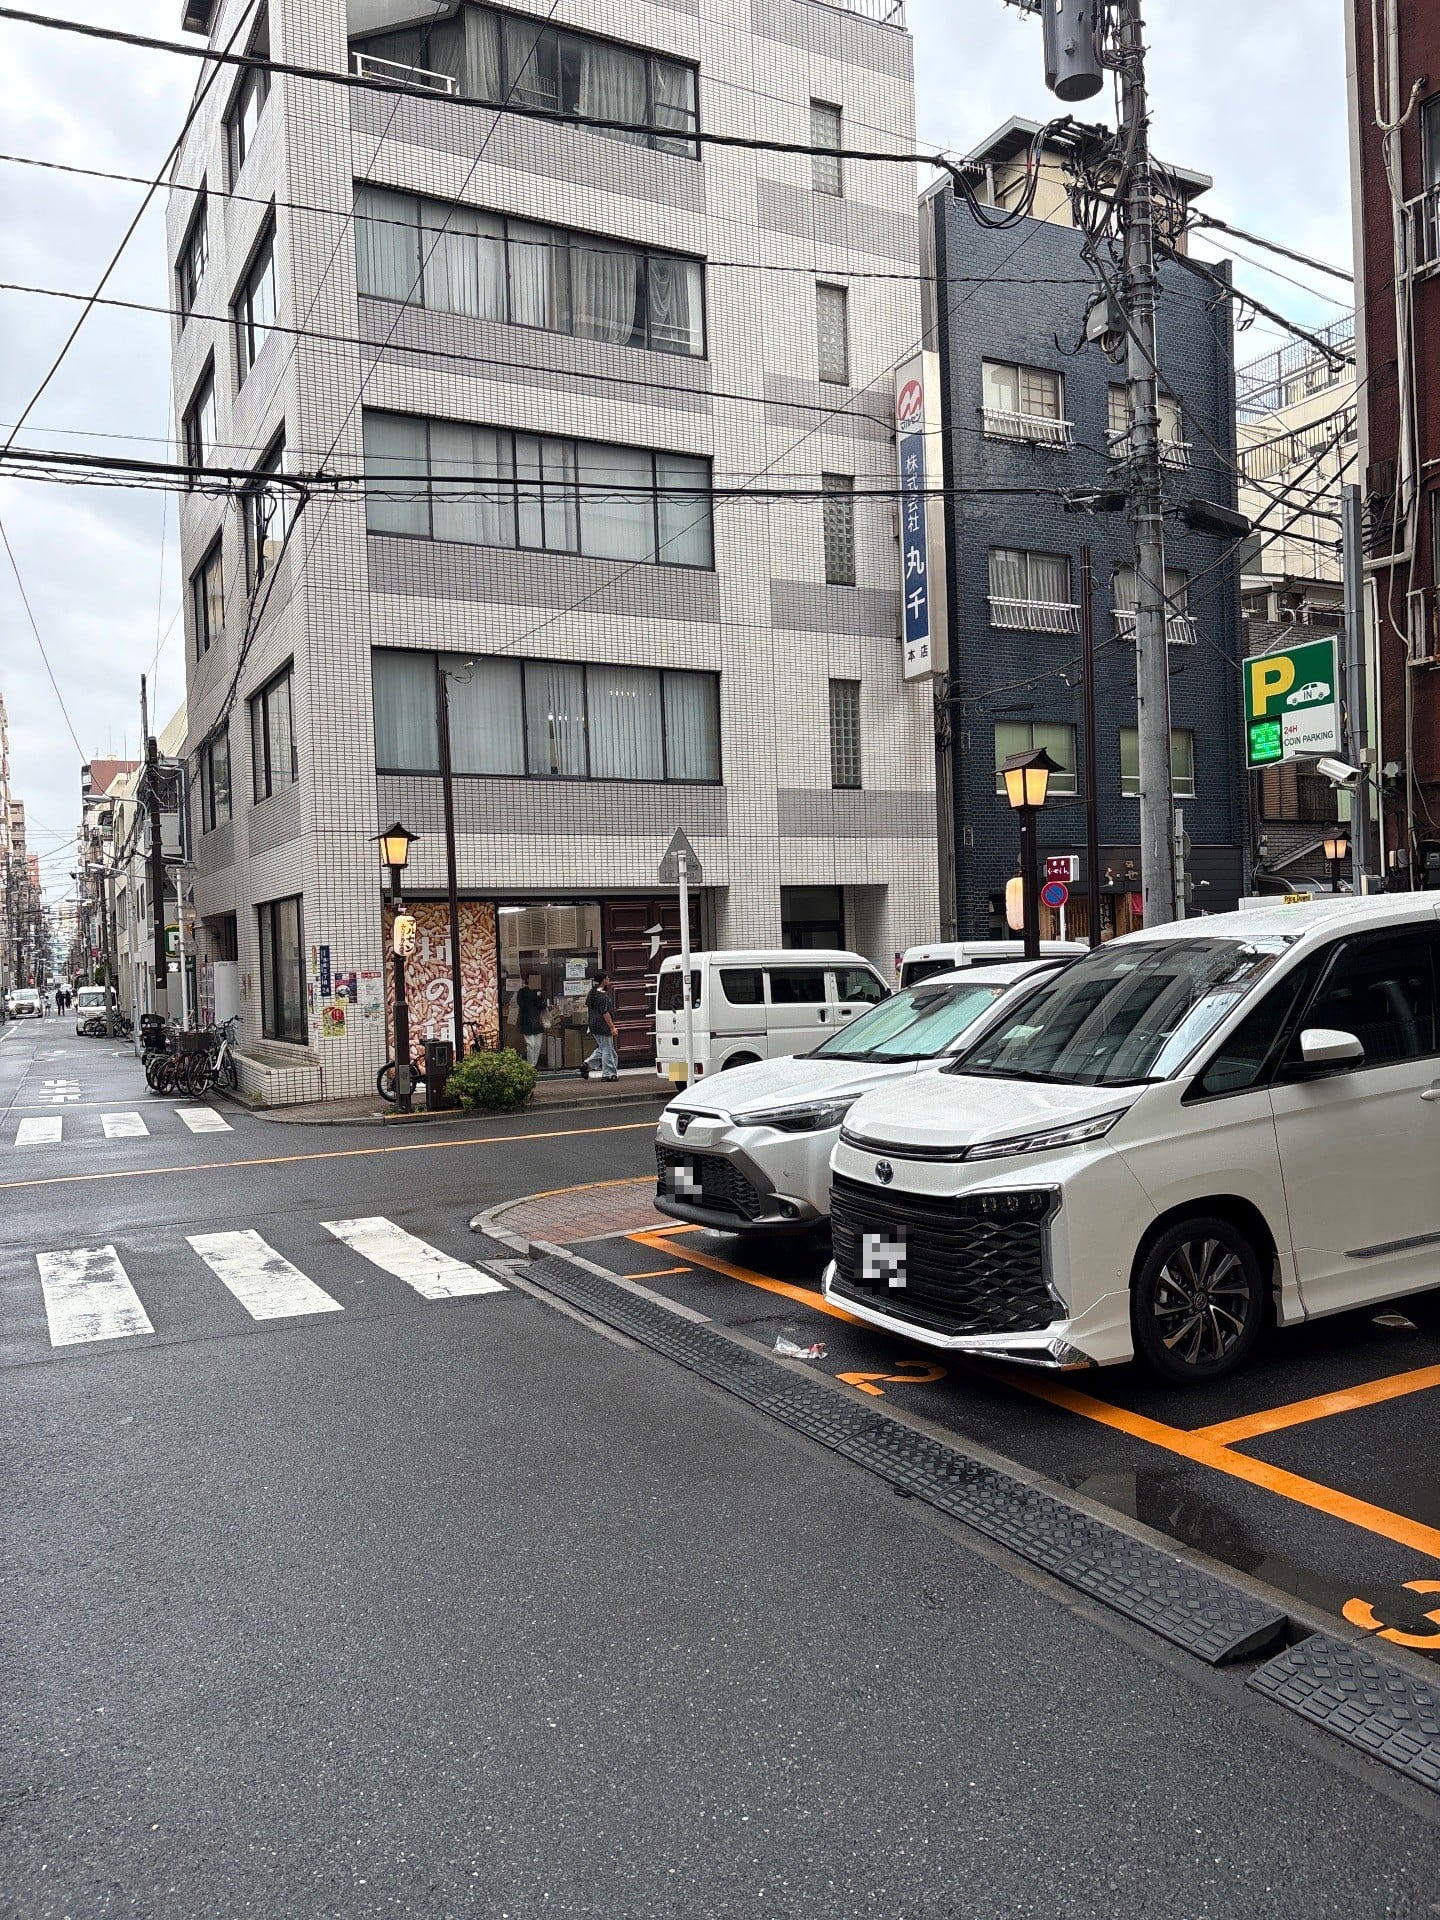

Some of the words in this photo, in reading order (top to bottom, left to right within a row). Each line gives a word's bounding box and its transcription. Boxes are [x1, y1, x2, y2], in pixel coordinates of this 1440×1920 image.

[905, 453, 920, 532] 株式会社
[906, 545, 926, 620] 丸千
[907, 644, 929, 663] 本店
[1251, 656, 1295, 717] P
[1303, 690, 1313, 700] IN
[1284, 725, 1298, 735] 24H
[1284, 736, 1301, 747] COIN
[1302, 730, 1333, 743] PARKING
[405, 919, 416, 953] マルセン
[835, 1360, 948, 1396] 2
